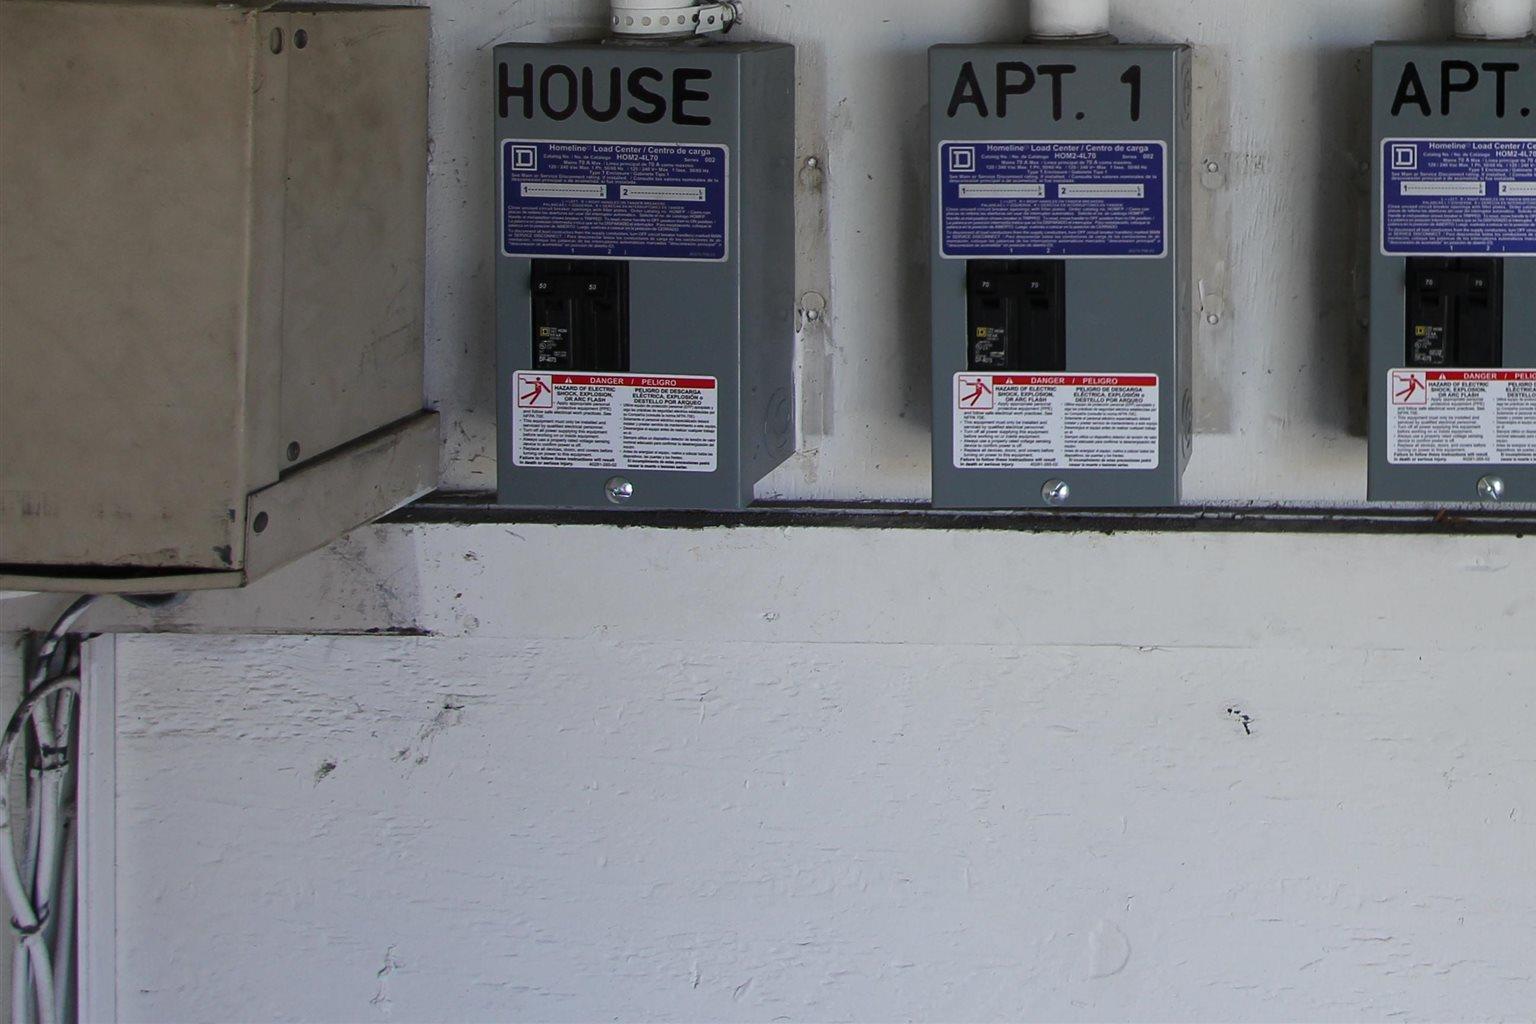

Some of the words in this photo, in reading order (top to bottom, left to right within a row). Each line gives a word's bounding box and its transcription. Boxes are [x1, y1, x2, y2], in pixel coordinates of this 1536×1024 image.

[498, 61, 712, 126] HOUSE
[947, 61, 1085, 122] APT.
[1120, 65, 1141, 121] 1
[1391, 60, 1530, 118] APT.
[648, 146, 674, 154] Centro
